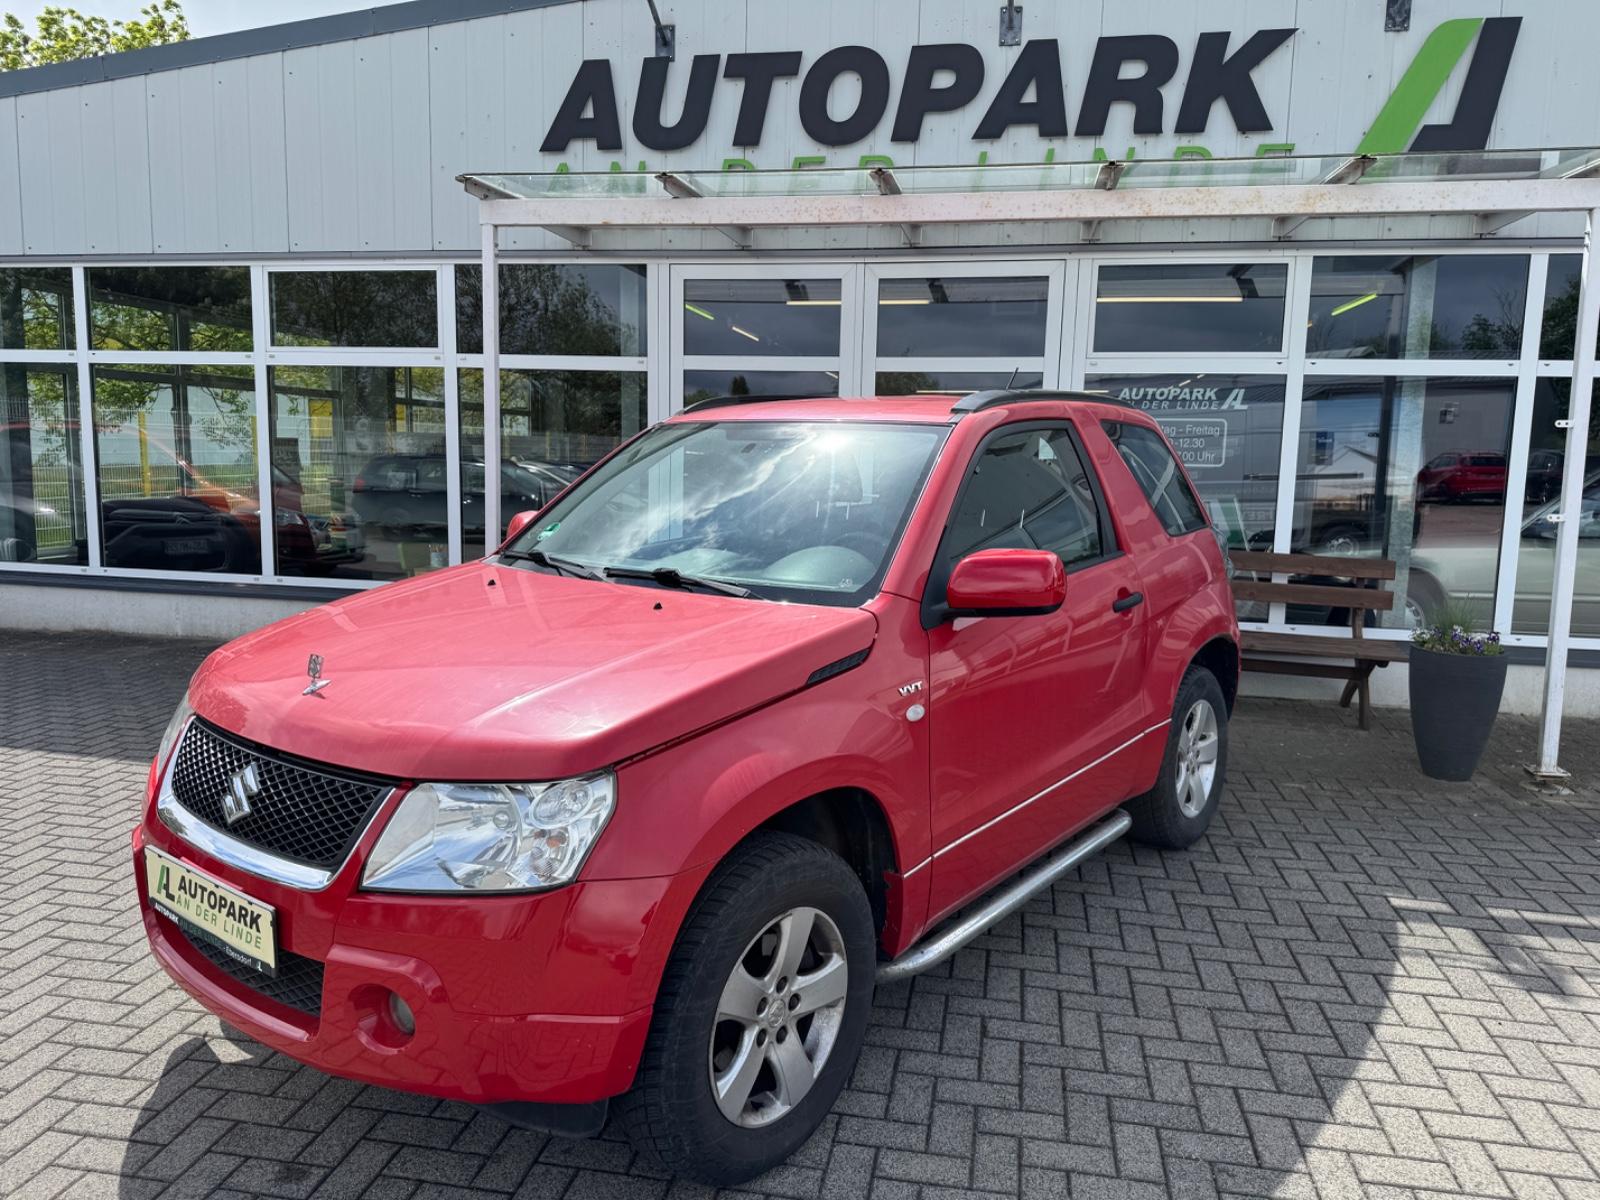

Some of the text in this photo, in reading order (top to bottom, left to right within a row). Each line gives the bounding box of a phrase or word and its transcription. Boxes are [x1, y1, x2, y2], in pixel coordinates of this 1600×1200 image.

[539, 27, 1300, 153] AUTOPARK
[549, 159, 647, 195] AN
[1118, 387, 1219, 401] AUTOPARK
[1141, 400, 1170, 410] DER
[1176, 400, 1220, 410] LINDE
[1161, 425, 1176, 437] ag
[1185, 424, 1220, 436] Freitag
[1197, 450, 1216, 462] Uhr
[178, 875, 262, 934] AUTOPARK
[176, 894, 190, 911] AN
[195, 904, 218, 927] DER
[223, 920, 262, 950] LINDE
